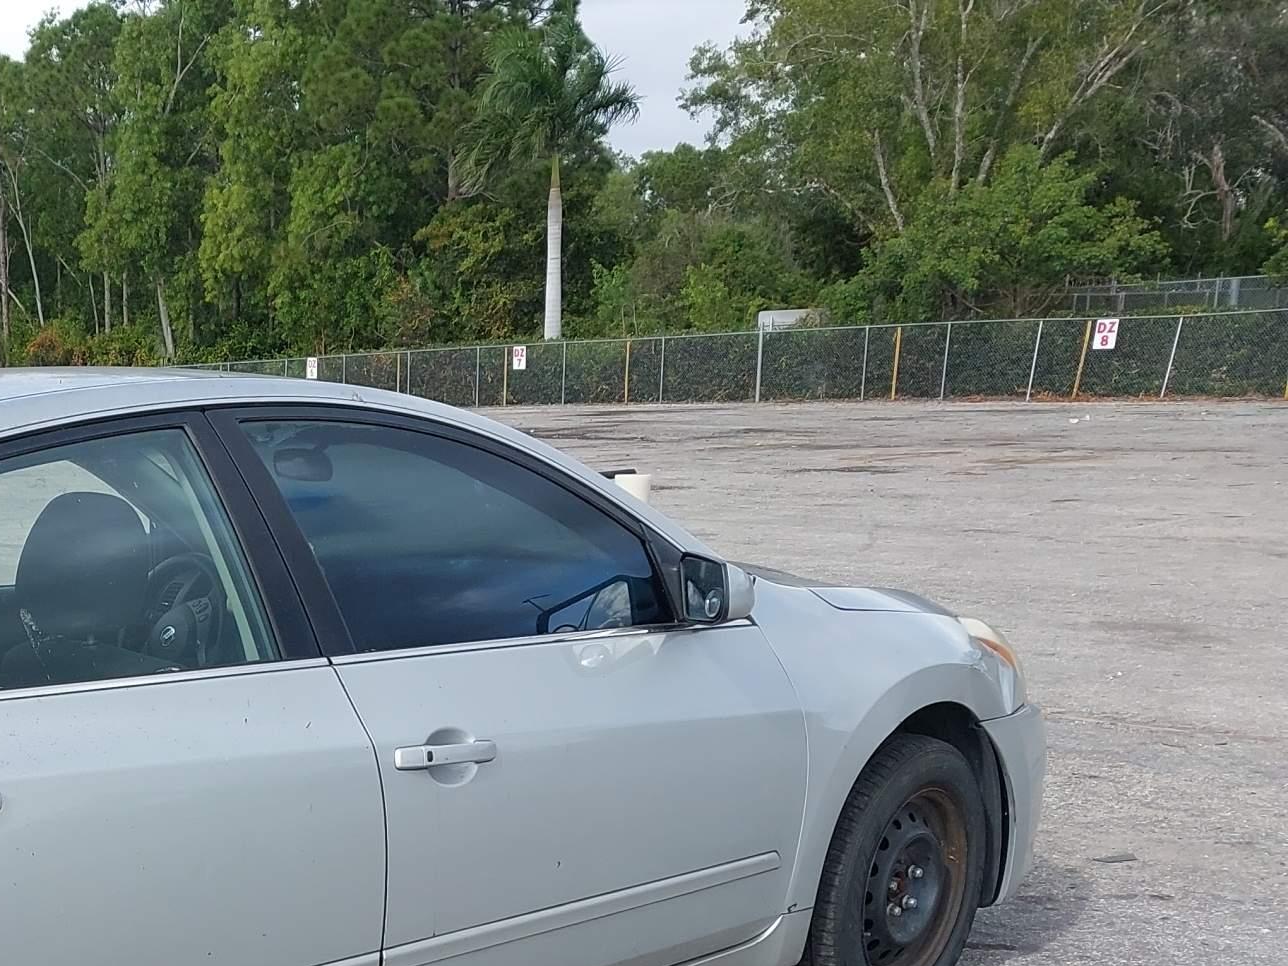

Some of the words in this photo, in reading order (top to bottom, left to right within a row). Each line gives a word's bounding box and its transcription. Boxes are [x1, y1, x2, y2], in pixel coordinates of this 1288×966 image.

[1097, 321, 1117, 334] DZ
[1100, 335, 1109, 346] 8
[514, 348, 525, 358] DZ
[516, 358, 523, 368] 7
